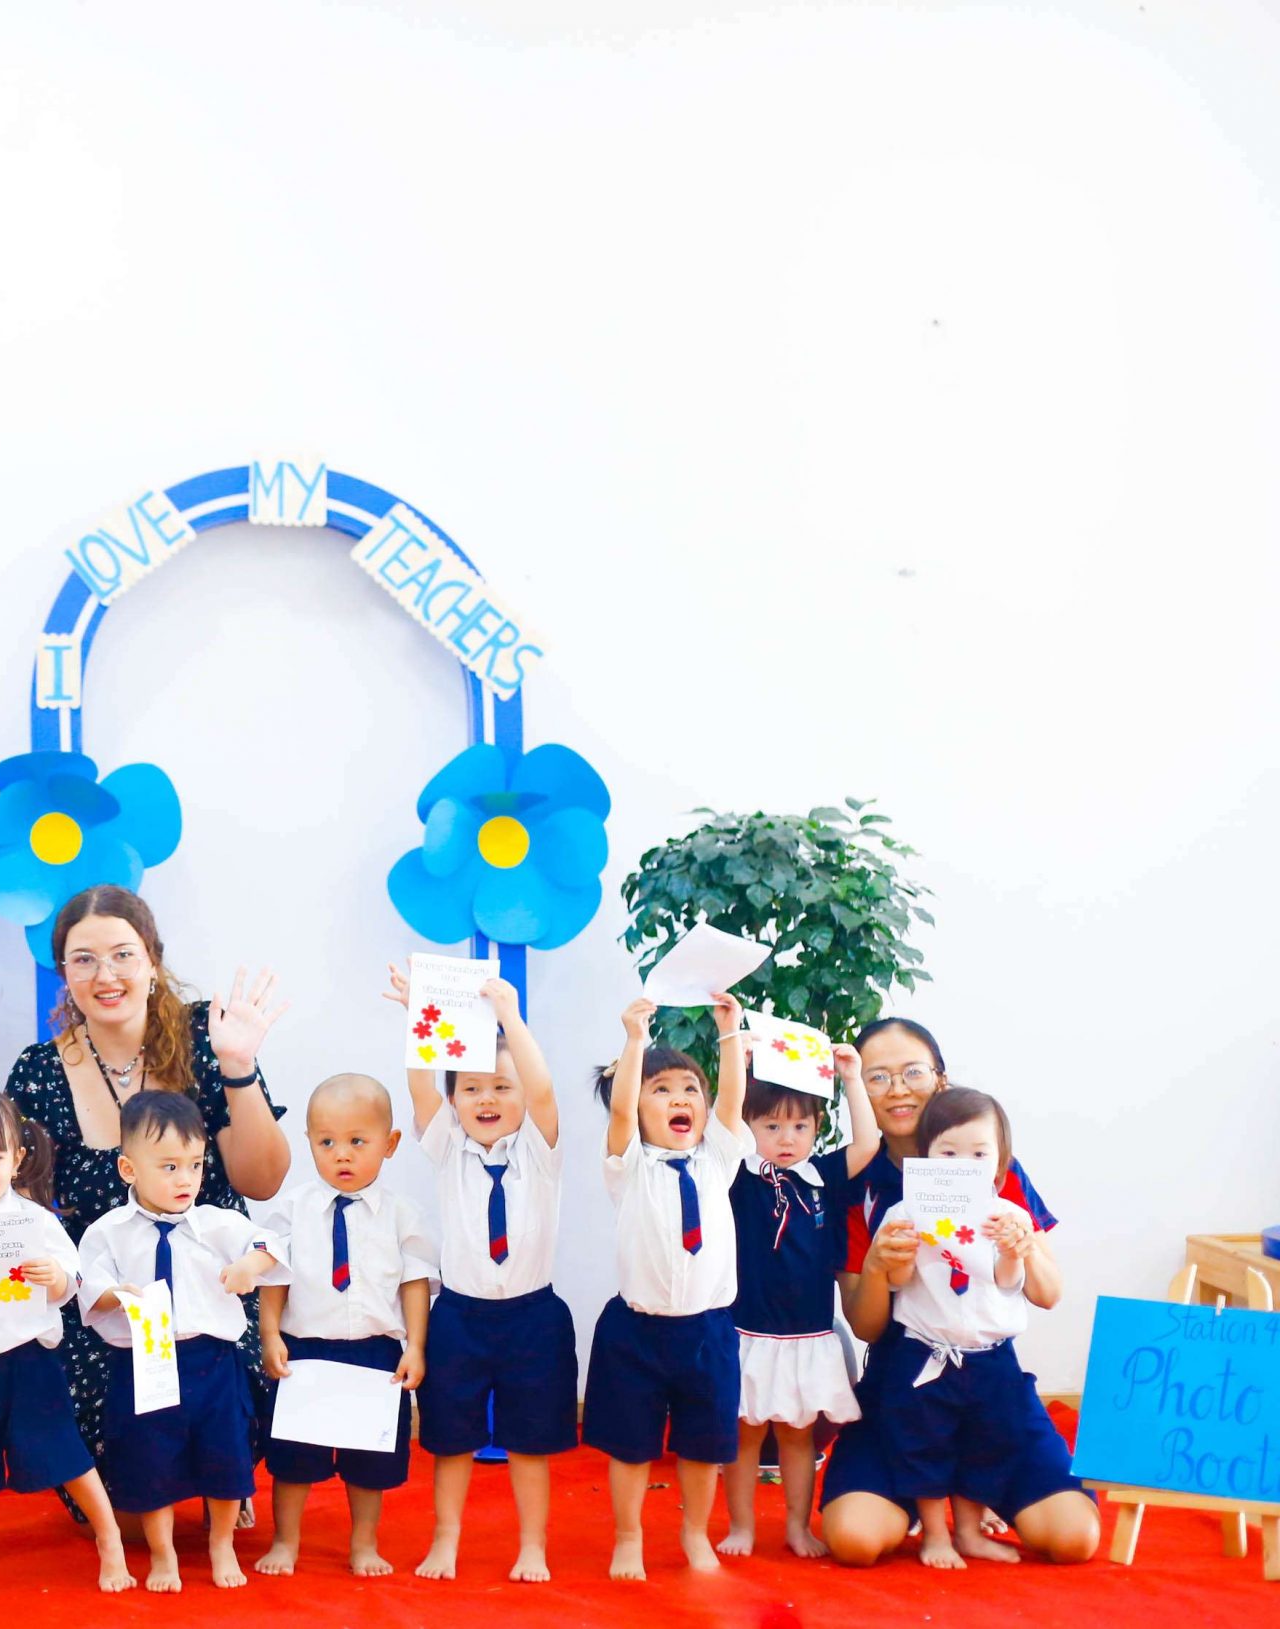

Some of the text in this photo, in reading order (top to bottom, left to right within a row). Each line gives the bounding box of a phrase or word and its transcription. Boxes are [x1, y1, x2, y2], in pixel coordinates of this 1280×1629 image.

[43, 460, 545, 702] I LOVE MY TEACHERS
[906, 1167, 935, 1176] Happy
[916, 1192, 970, 1203] Thank you,
[920, 1205, 960, 1213] teacher
[2, 1241, 24, 1250] you,
[1153, 1304, 1257, 1345] Station
[1112, 1346, 1265, 1426] Photo
[1154, 1426, 1280, 1496] Boot
